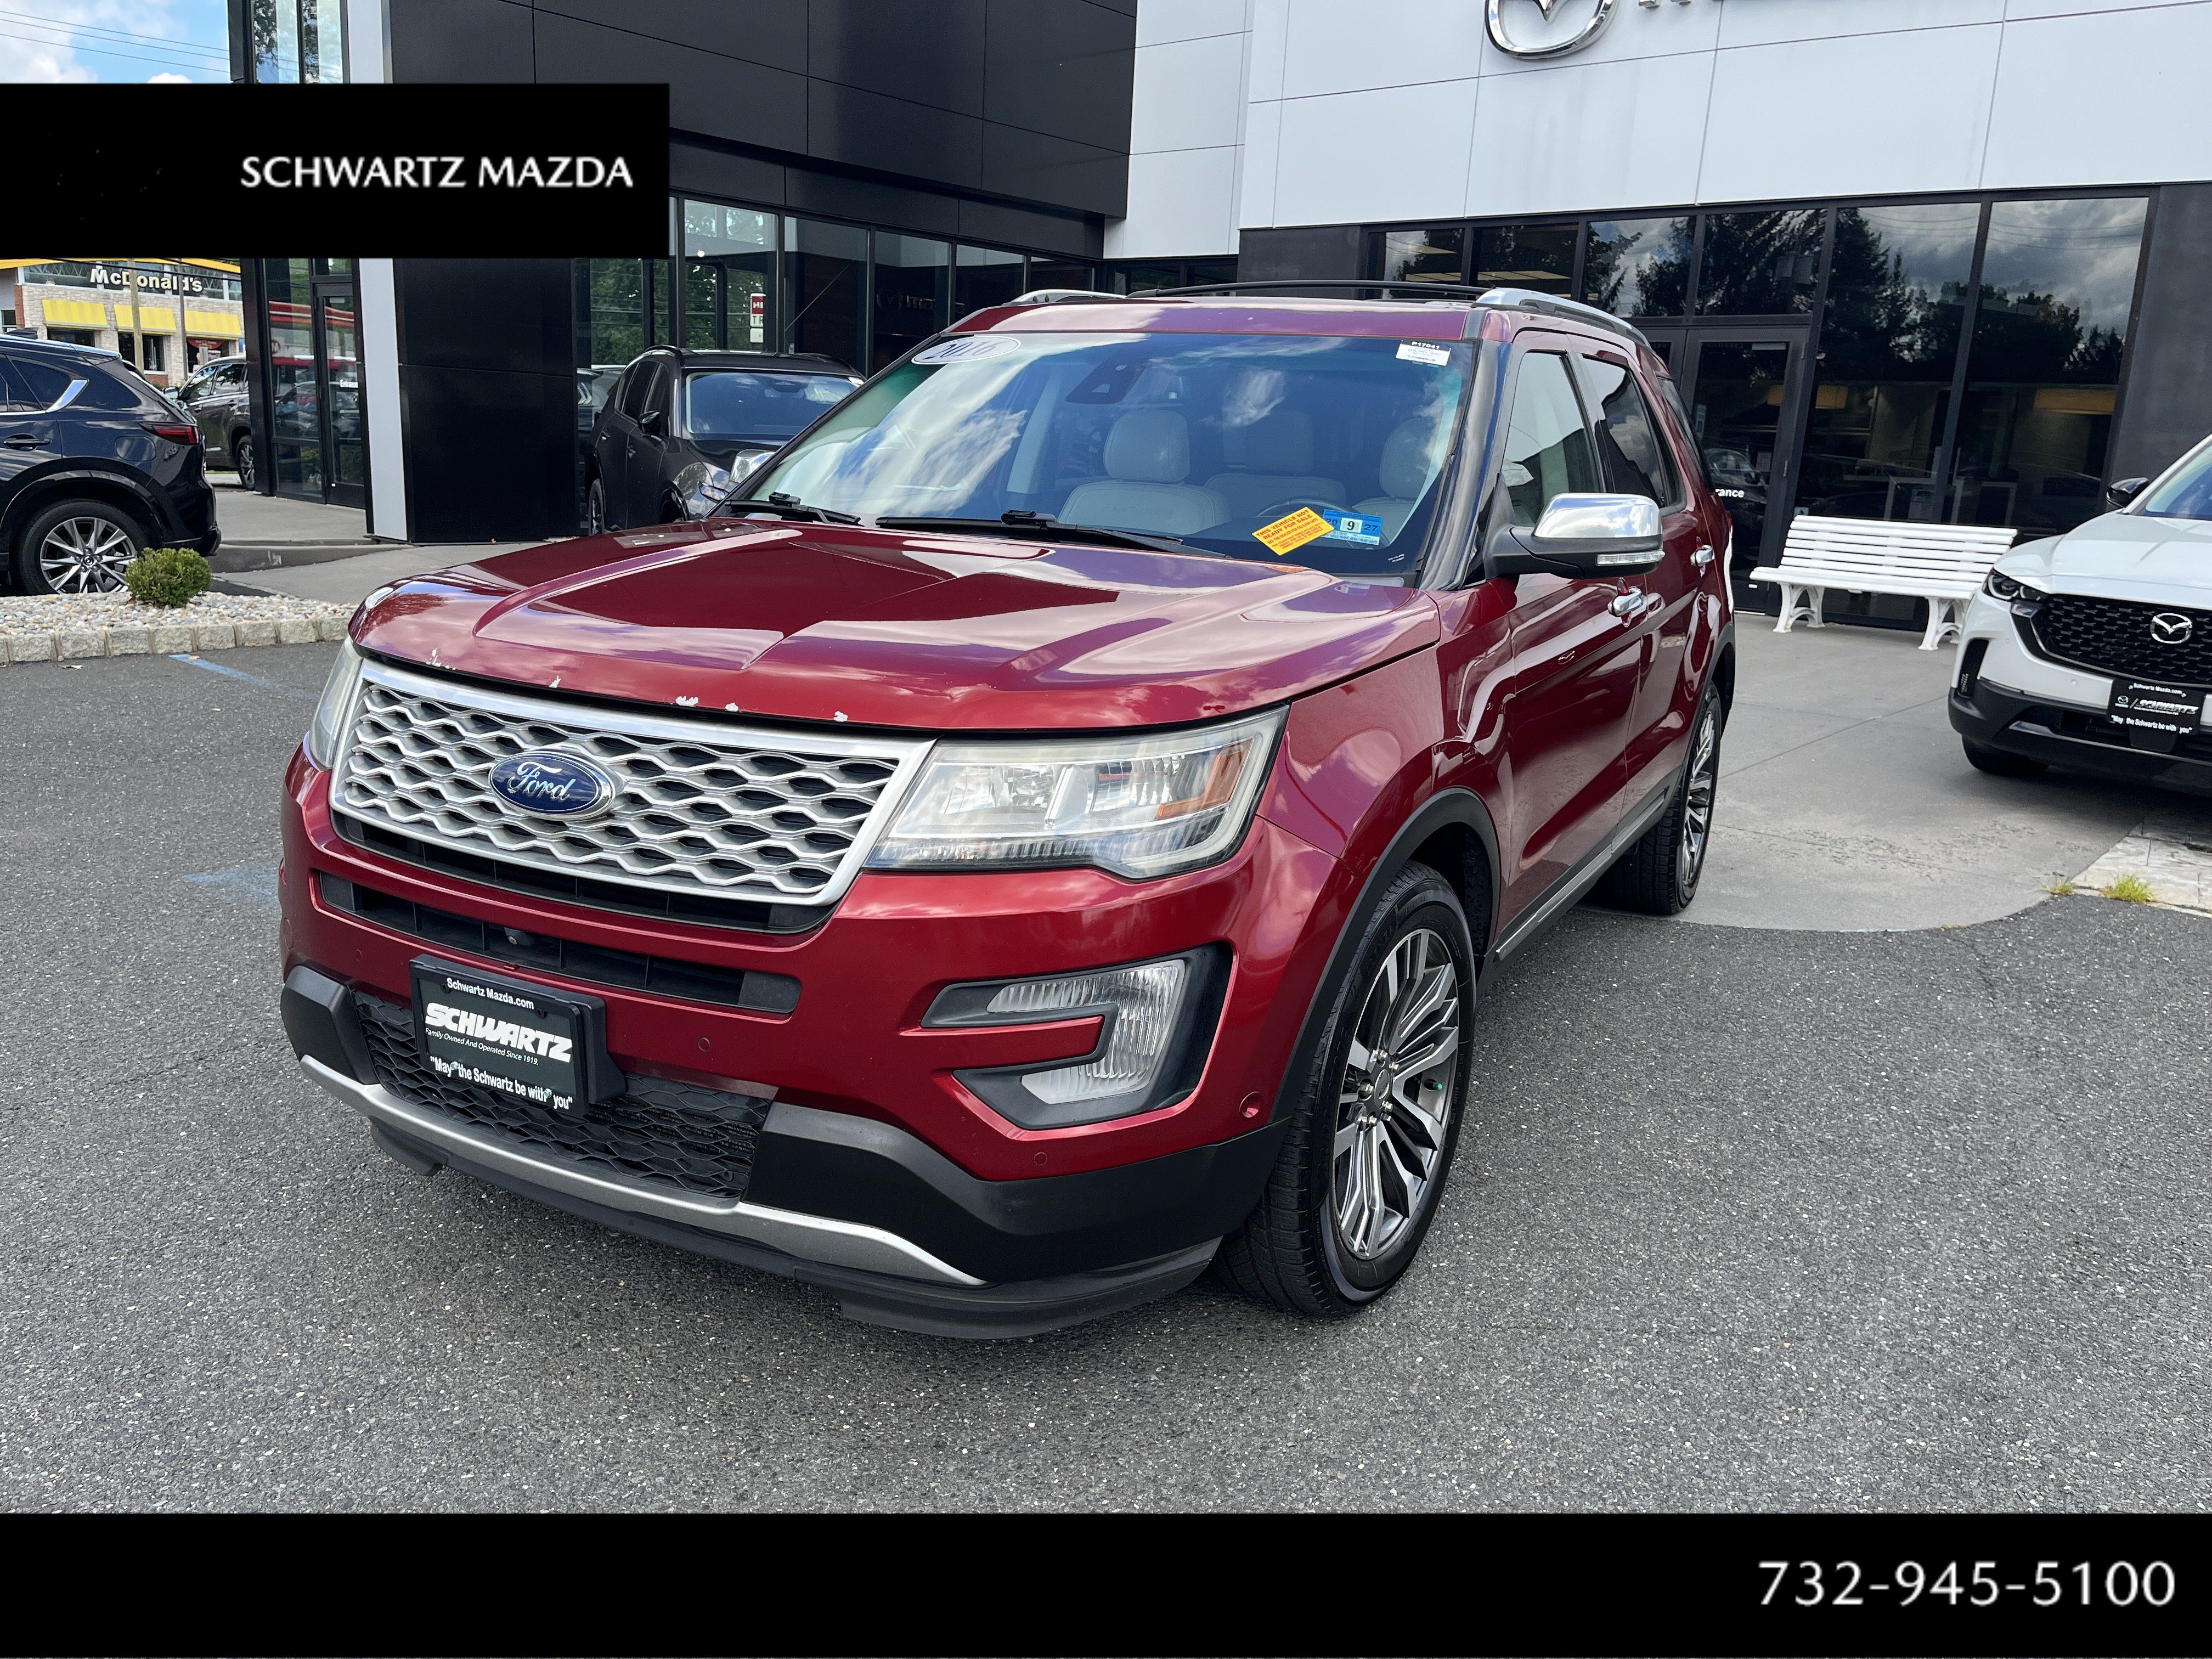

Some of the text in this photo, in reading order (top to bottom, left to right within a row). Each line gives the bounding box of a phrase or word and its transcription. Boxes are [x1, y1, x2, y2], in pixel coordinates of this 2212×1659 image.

[922, 340, 1011, 360] 2016
[1255, 528, 1271, 537] THIS
[1270, 515, 1297, 530] VEHICLE
[1295, 509, 1310, 517] NOT
[1262, 527, 1284, 540] READY
[1283, 521, 1297, 529] FOR
[1295, 514, 1313, 523] SALE
[1347, 521, 1355, 531] 9
[1364, 523, 1379, 532] 27
[506, 761, 577, 803] Ford
[447, 977, 534, 1010] Schwartz Mazda.com
[425, 1002, 573, 1063] SCHWARTZ
[425, 1028, 539, 1065] Family Owned And Operated Since 1919.
[458, 1062, 472, 1080] the
[473, 1068, 514, 1092] Schwartz
[515, 1079, 527, 1096] be
[527, 1085, 547, 1103] with
[552, 1094, 573, 1110] you"
